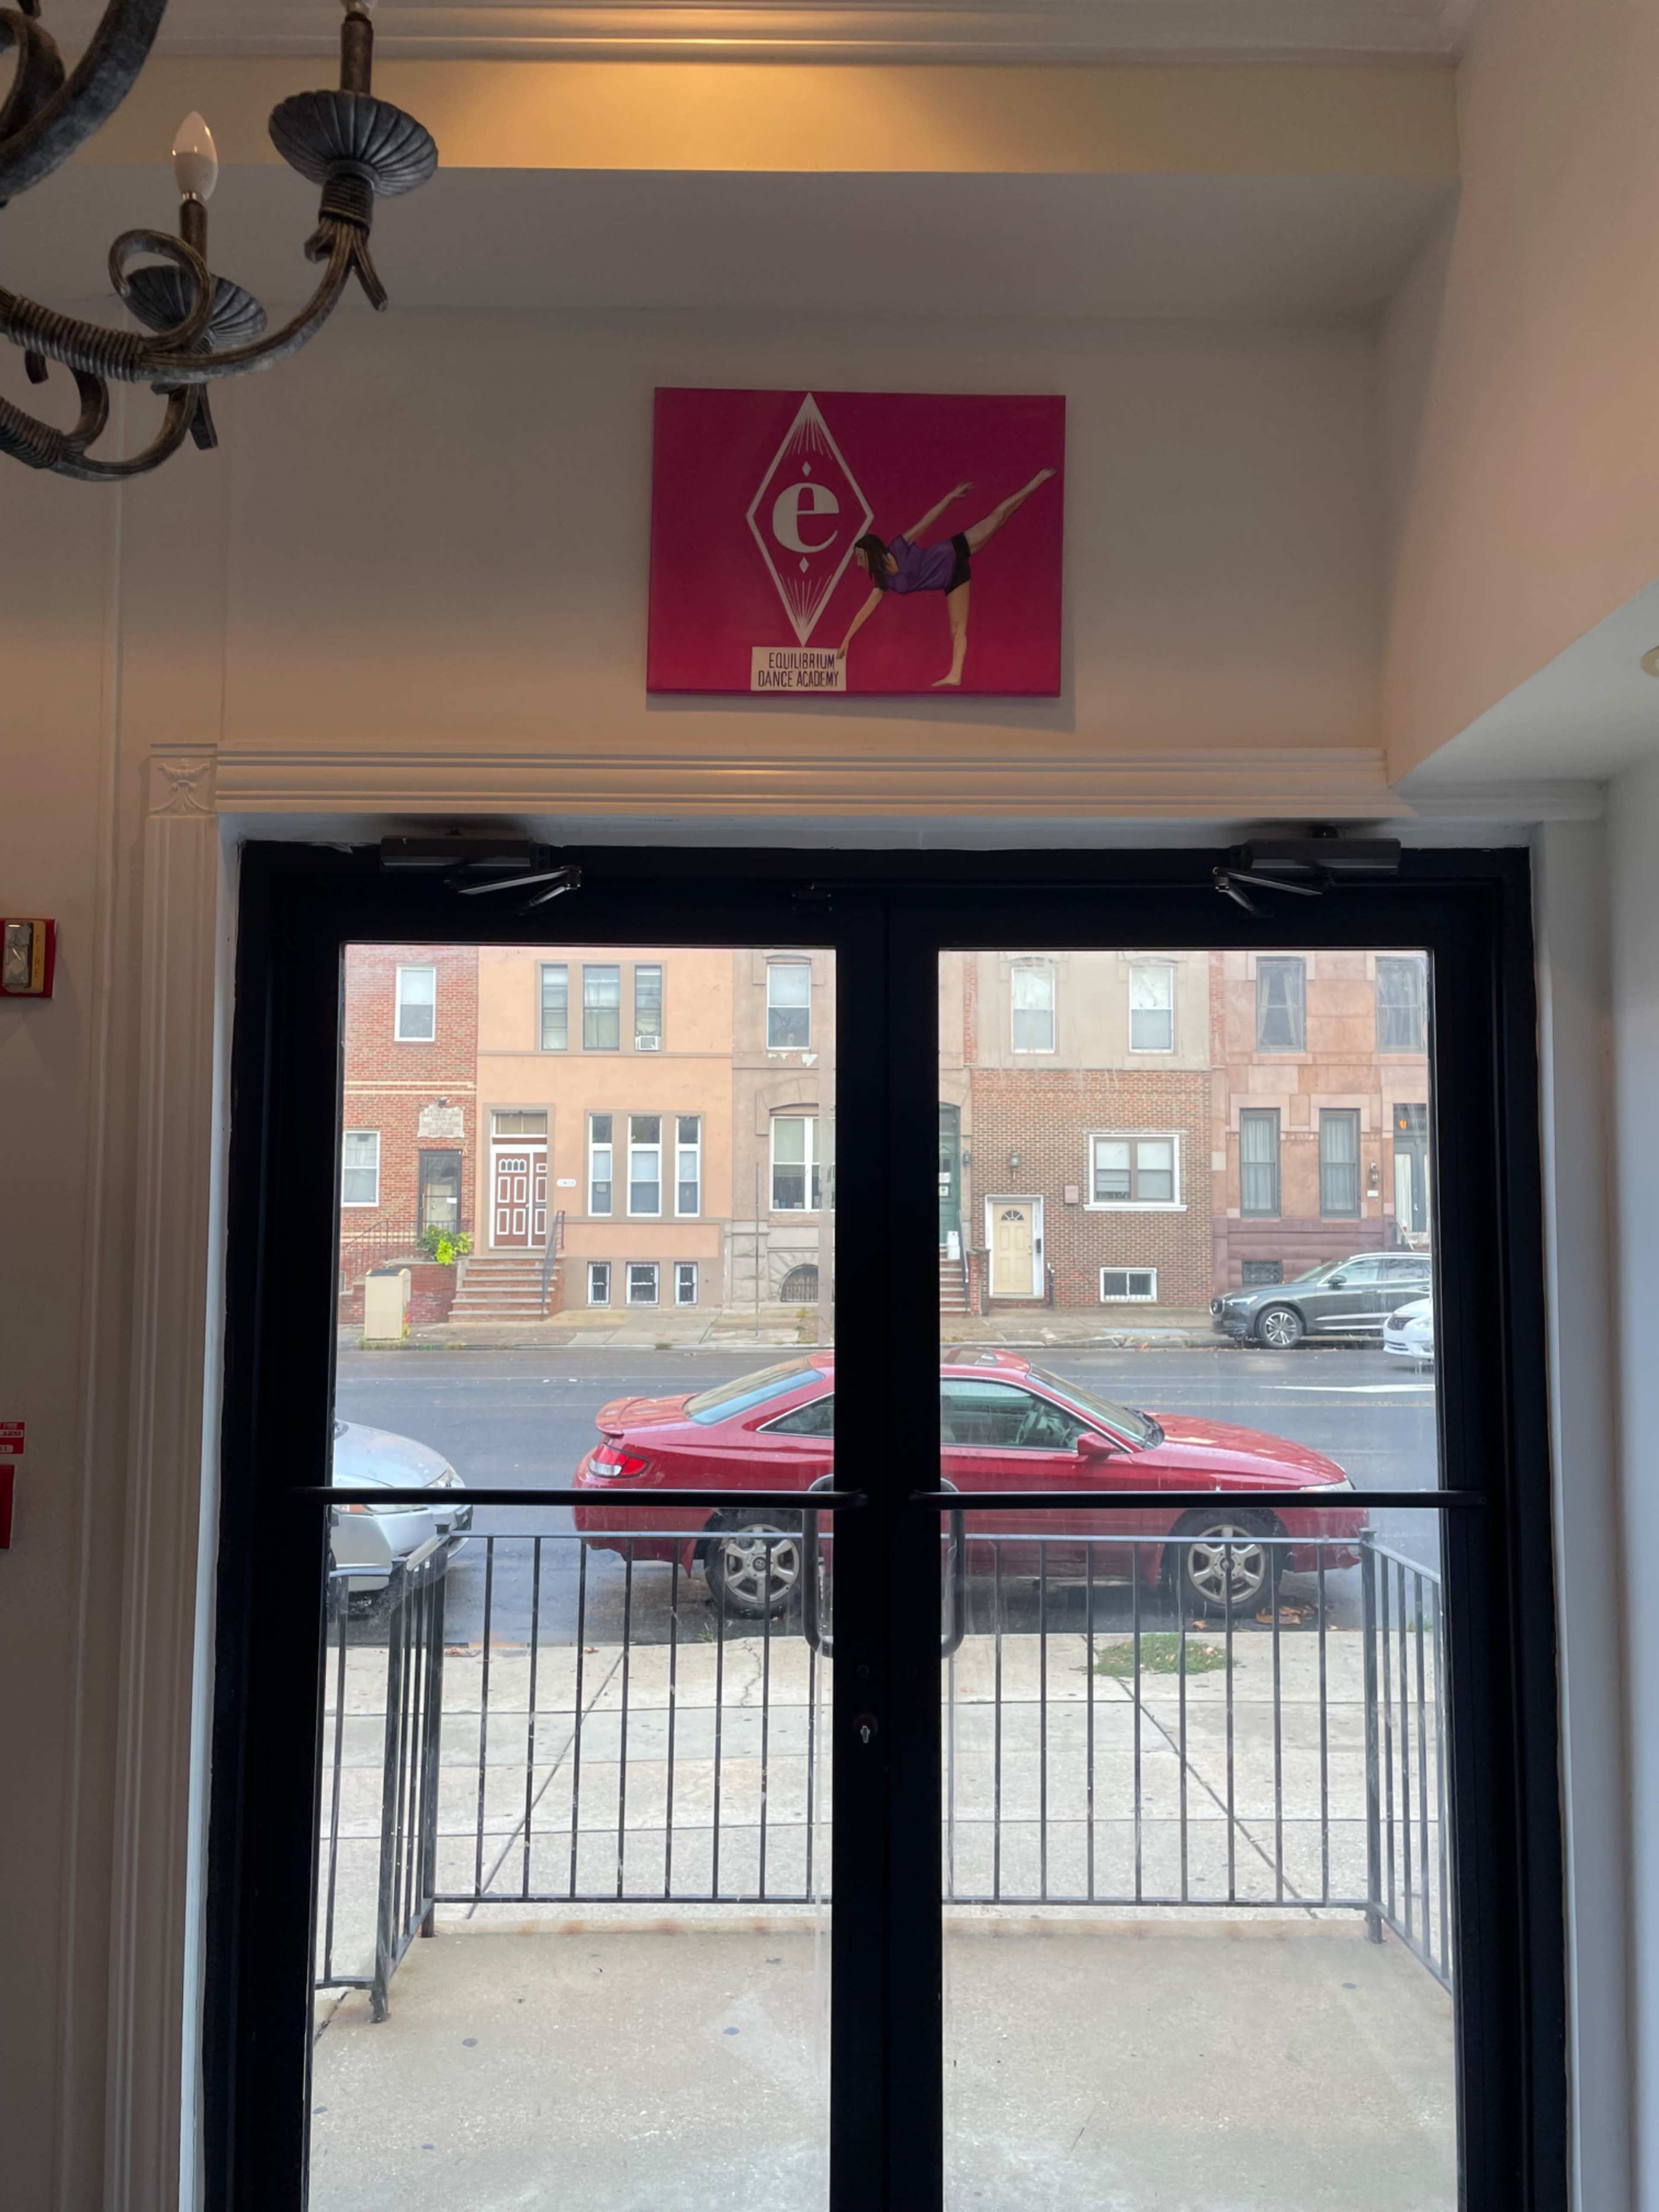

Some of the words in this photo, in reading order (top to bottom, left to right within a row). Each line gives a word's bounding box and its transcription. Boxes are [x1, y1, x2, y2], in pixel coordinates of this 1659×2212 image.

[769, 652, 835, 669] EQUILIBRIUM
[758, 670, 794, 687] DANCE
[796, 671, 839, 687] ACADEMY
